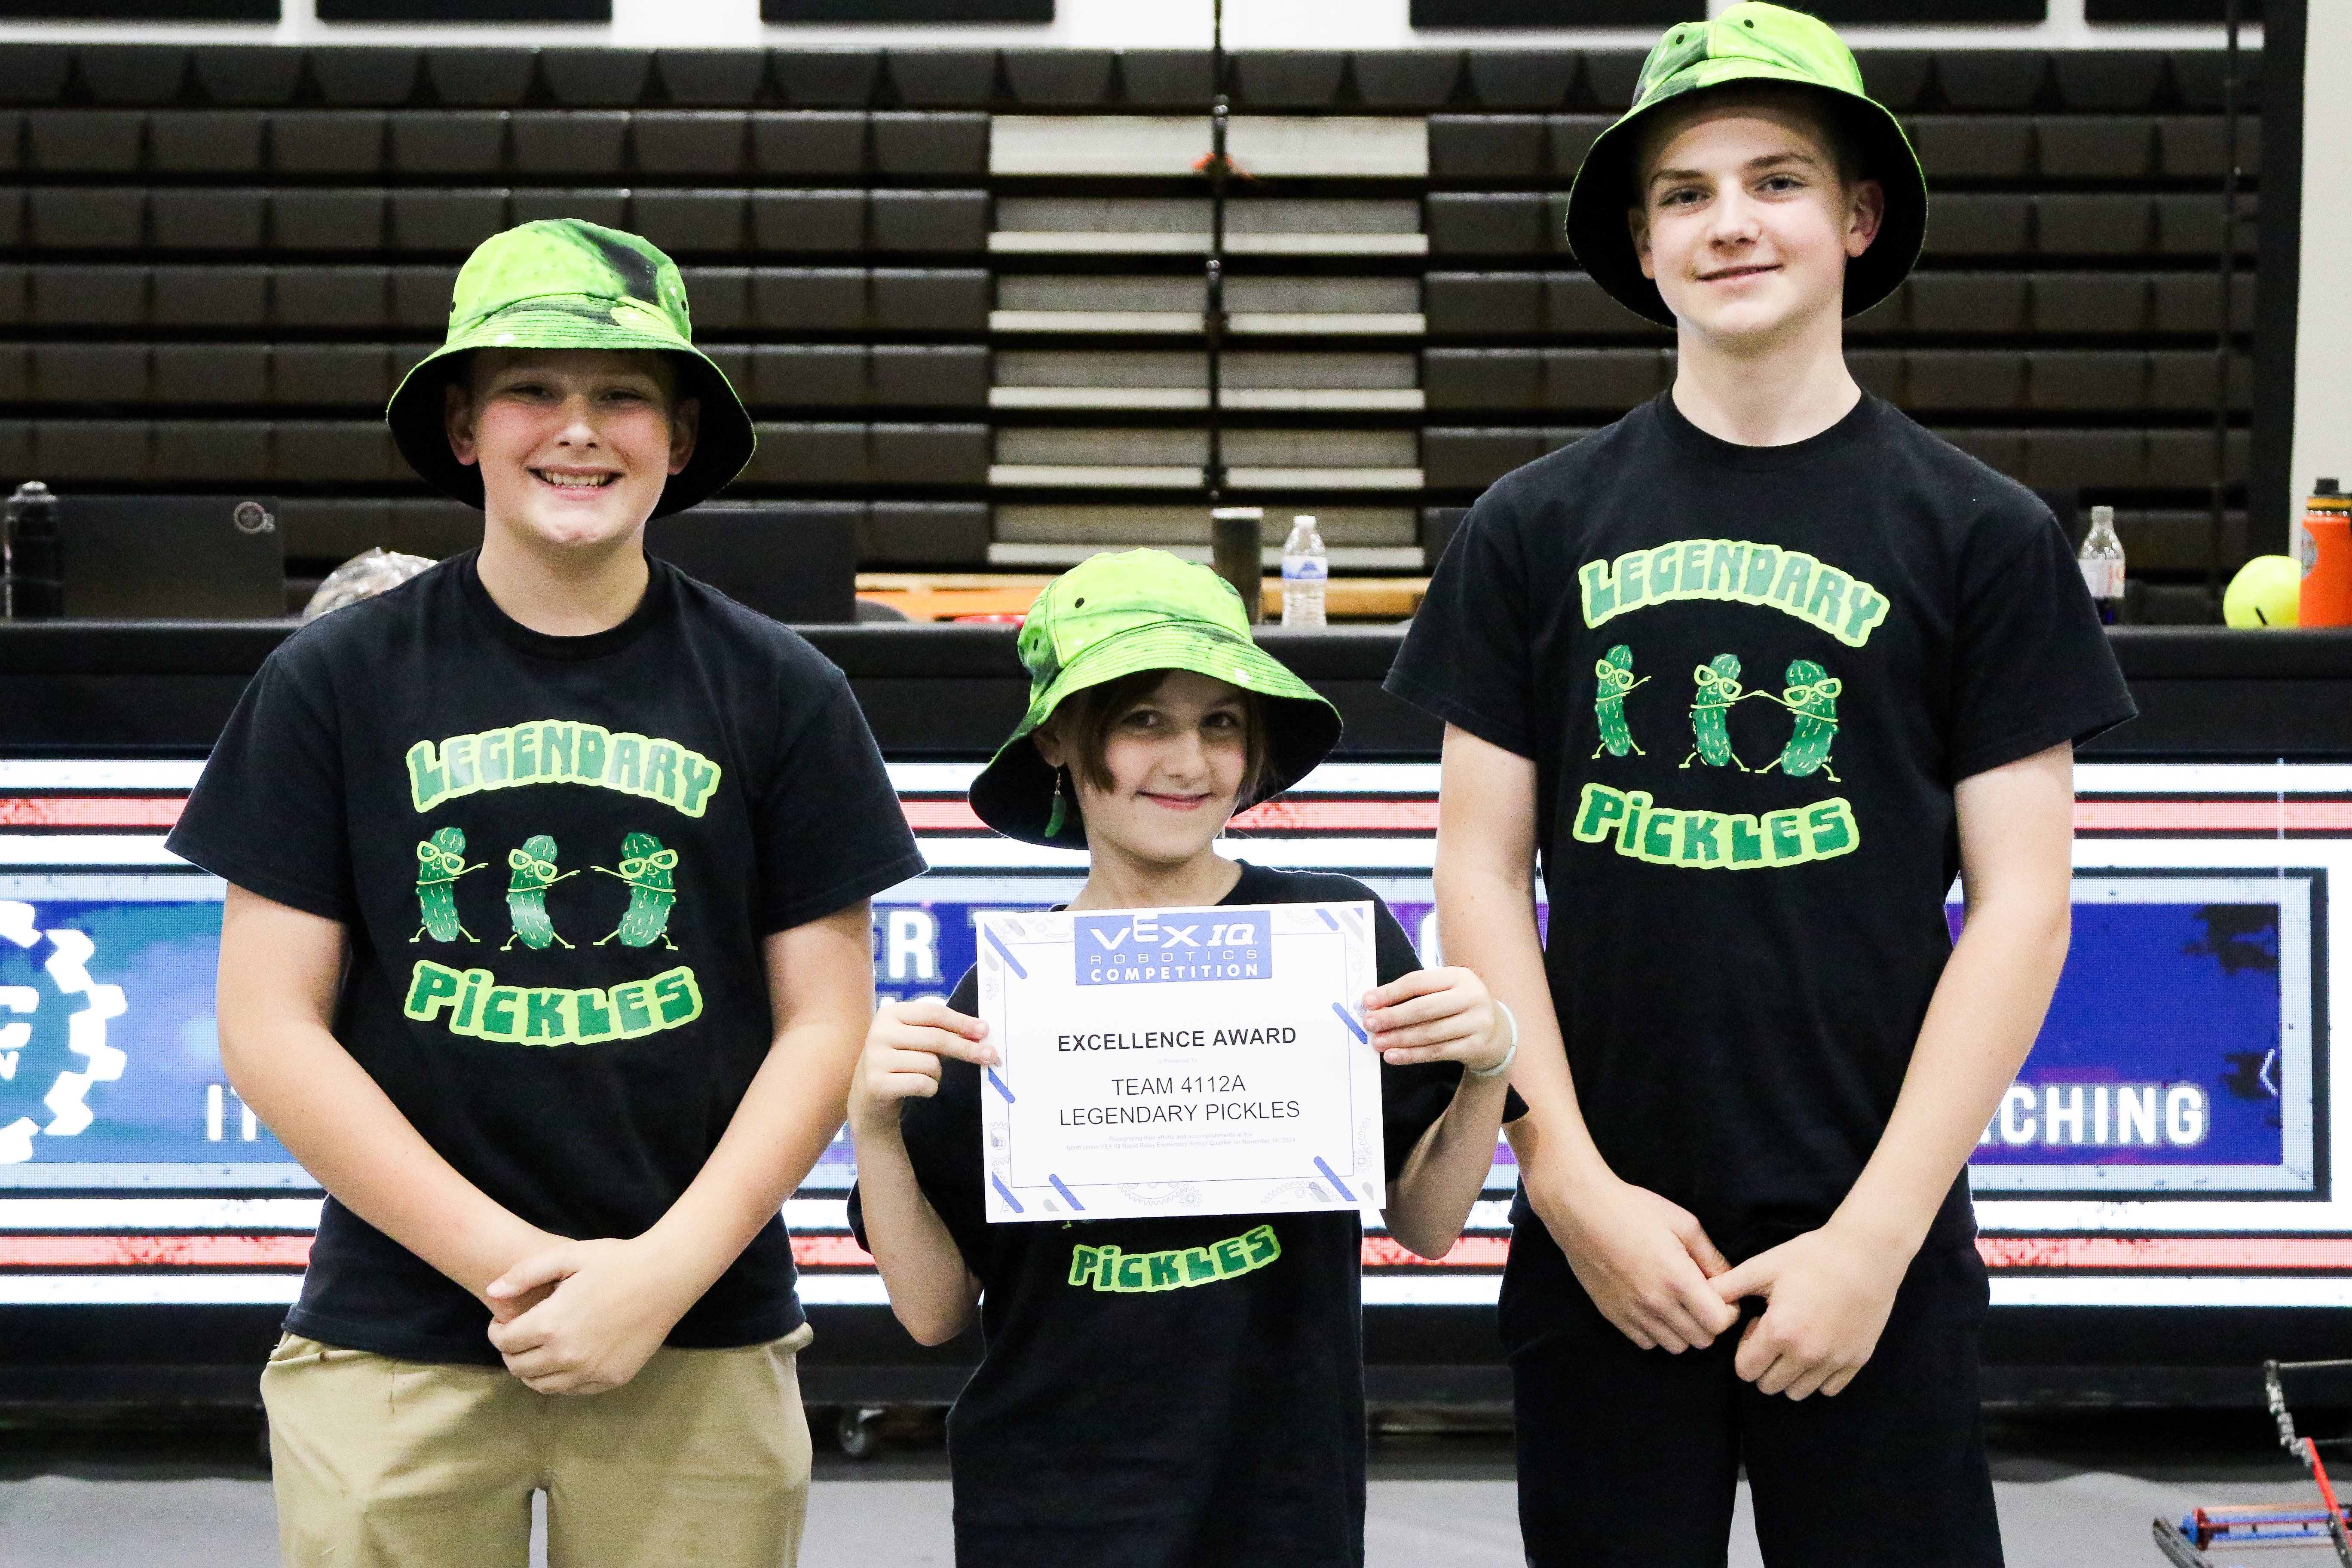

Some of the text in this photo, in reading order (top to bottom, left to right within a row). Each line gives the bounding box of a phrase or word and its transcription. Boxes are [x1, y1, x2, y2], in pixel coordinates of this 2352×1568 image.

[1578, 539, 1890, 647] LEGENDARY
[406, 719, 721, 818] LEGENDARY
[1090, 914, 1255, 950] VEX IQ
[1090, 949, 1257, 965] ROBOTICS
[1090, 963, 1258, 982] COMPETITION
[1058, 1027, 1296, 1051] EXCELLENCE AWARD
[1112, 1076, 1246, 1096] TEAM 4112A
[1060, 1100, 1299, 1126] LEGENDARY PICKLES
[1980, 1087, 2204, 1145] CHING
